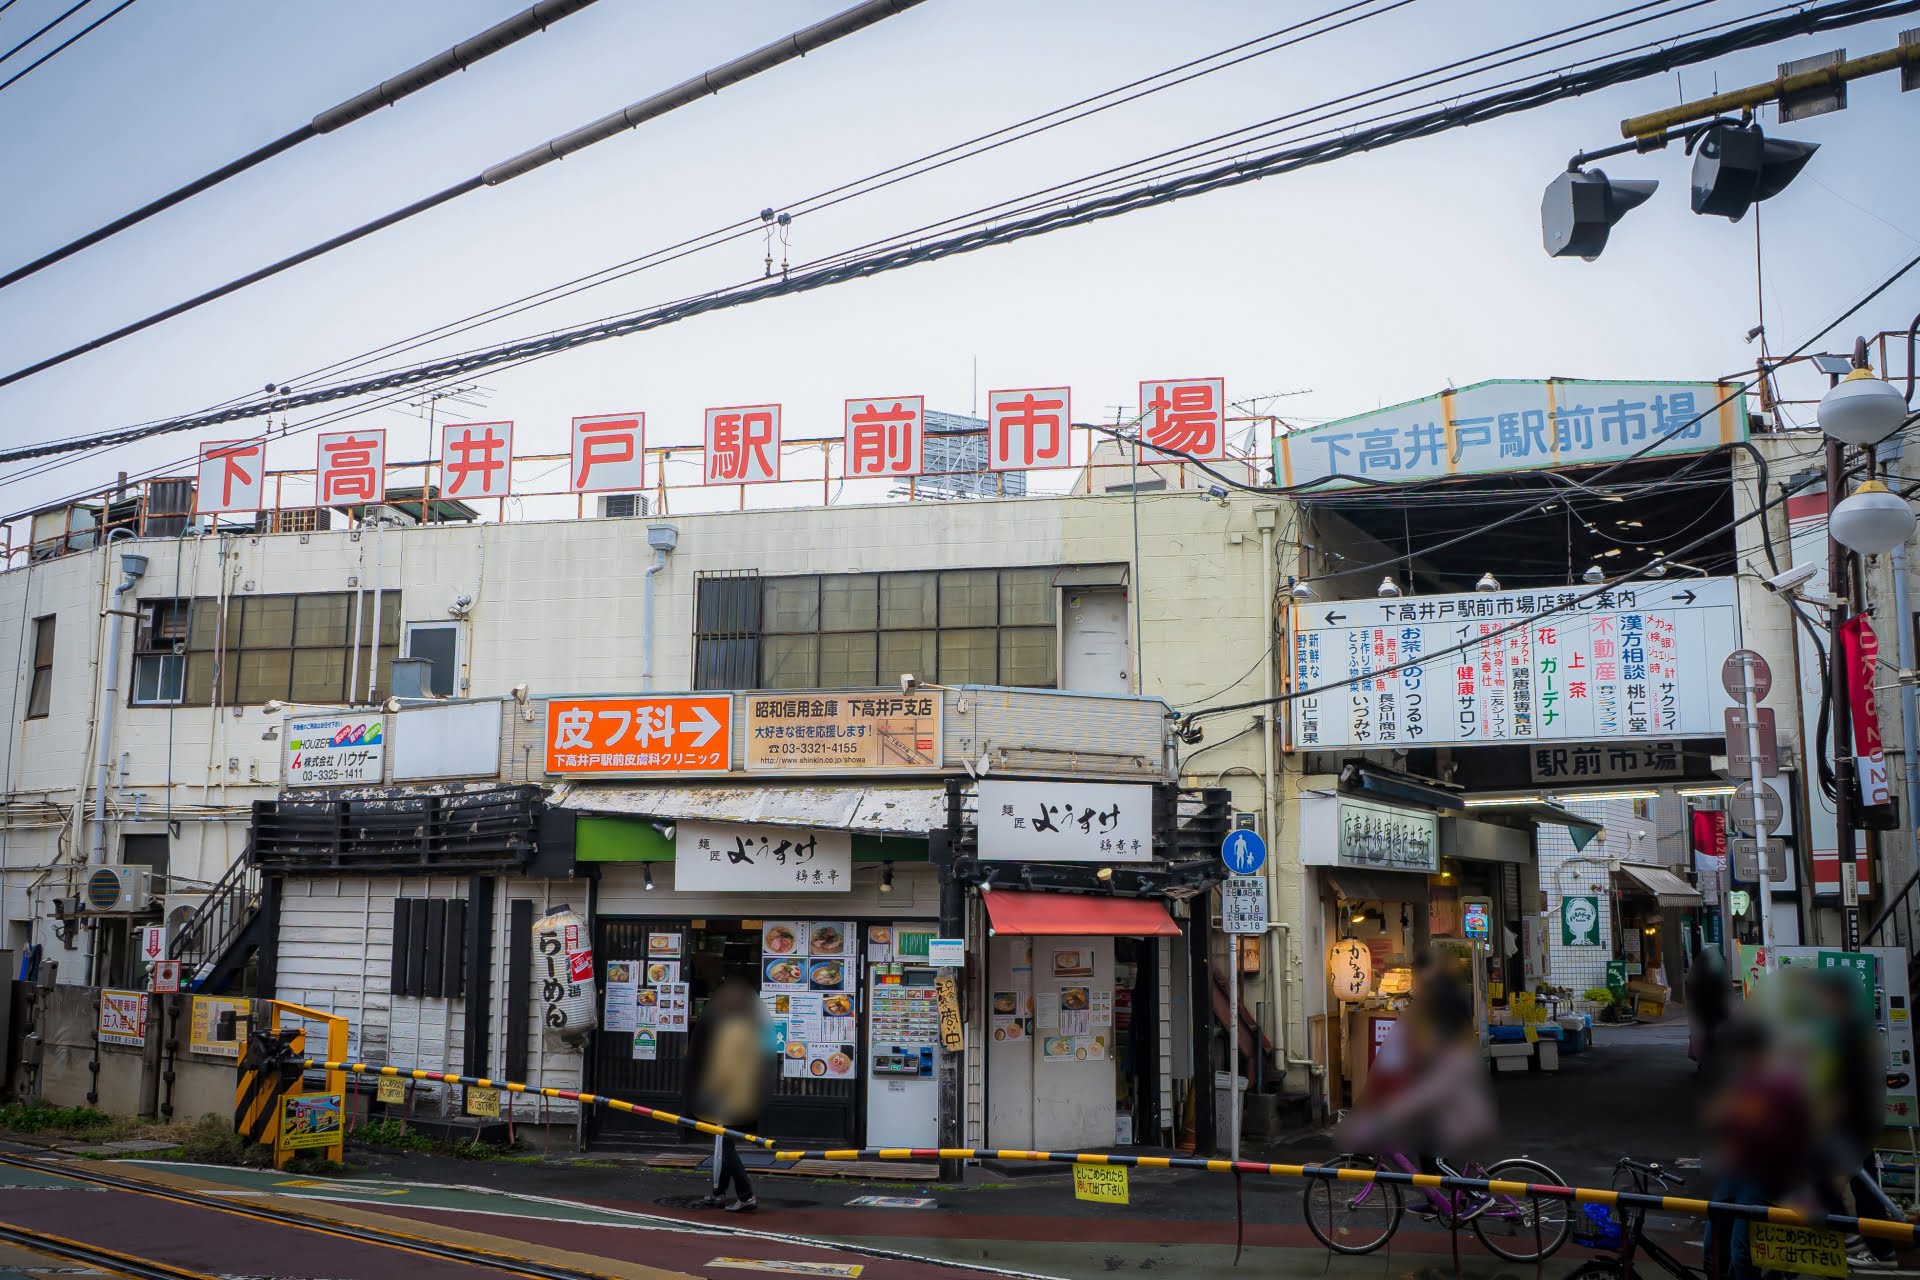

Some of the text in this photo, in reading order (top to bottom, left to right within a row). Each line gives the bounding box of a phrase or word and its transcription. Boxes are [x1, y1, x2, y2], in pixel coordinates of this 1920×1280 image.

[204, 384, 1214, 507] 下高井戸駅前市場
[1311, 391, 1702, 476] 下高井戸駅前市場
[1592, 616, 1616, 680] 不動産
[1620, 615, 1645, 680] 漢方相談
[1538, 626, 1560, 726] 花 ガーデナ
[755, 698, 933, 718] 昭和信用金庫 下高井戸支店
[1302, 697, 1319, 744] 山仁青果
[1352, 695, 1371, 741] いづみや
[1379, 693, 1396, 741] 長谷川商店
[1405, 693, 1423, 740] つるや
[1627, 684, 1647, 733] 桃仁堂
[1659, 683, 1677, 731] サクライ
[555, 704, 675, 749] 皮フ科
[755, 724, 872, 739] 大好きな街を応援します！
[304, 750, 378, 768] 株式会社 ハウザー
[554, 752, 721, 767] 下高井戸駅前皮膚科クリニック
[760, 756, 866, 765] http://www.shinkin.co.jp/showa
[782, 742, 857, 754] 03-3321-4155
[1536, 742, 1677, 777] 駅前市場
[302, 768, 363, 782] 03-3325-1411
[1866, 727, 1891, 805] 2020
[1032, 802, 1120, 834] ようすけ
[727, 834, 818, 865] ようすけ
[1226, 880, 1263, 888] 自転車を除く
[540, 930, 568, 1028] らーめん
[1347, 945, 1365, 995] からあげ
[103, 1013, 135, 1030] 立入禁止
[1077, 1166, 1124, 1182] とじこめられたら
[1077, 1180, 1125, 1196] 押して出て下さい
[1755, 1226, 1839, 1250] とじこめられたら
[1755, 1242, 1842, 1266] 押して出て下さい
